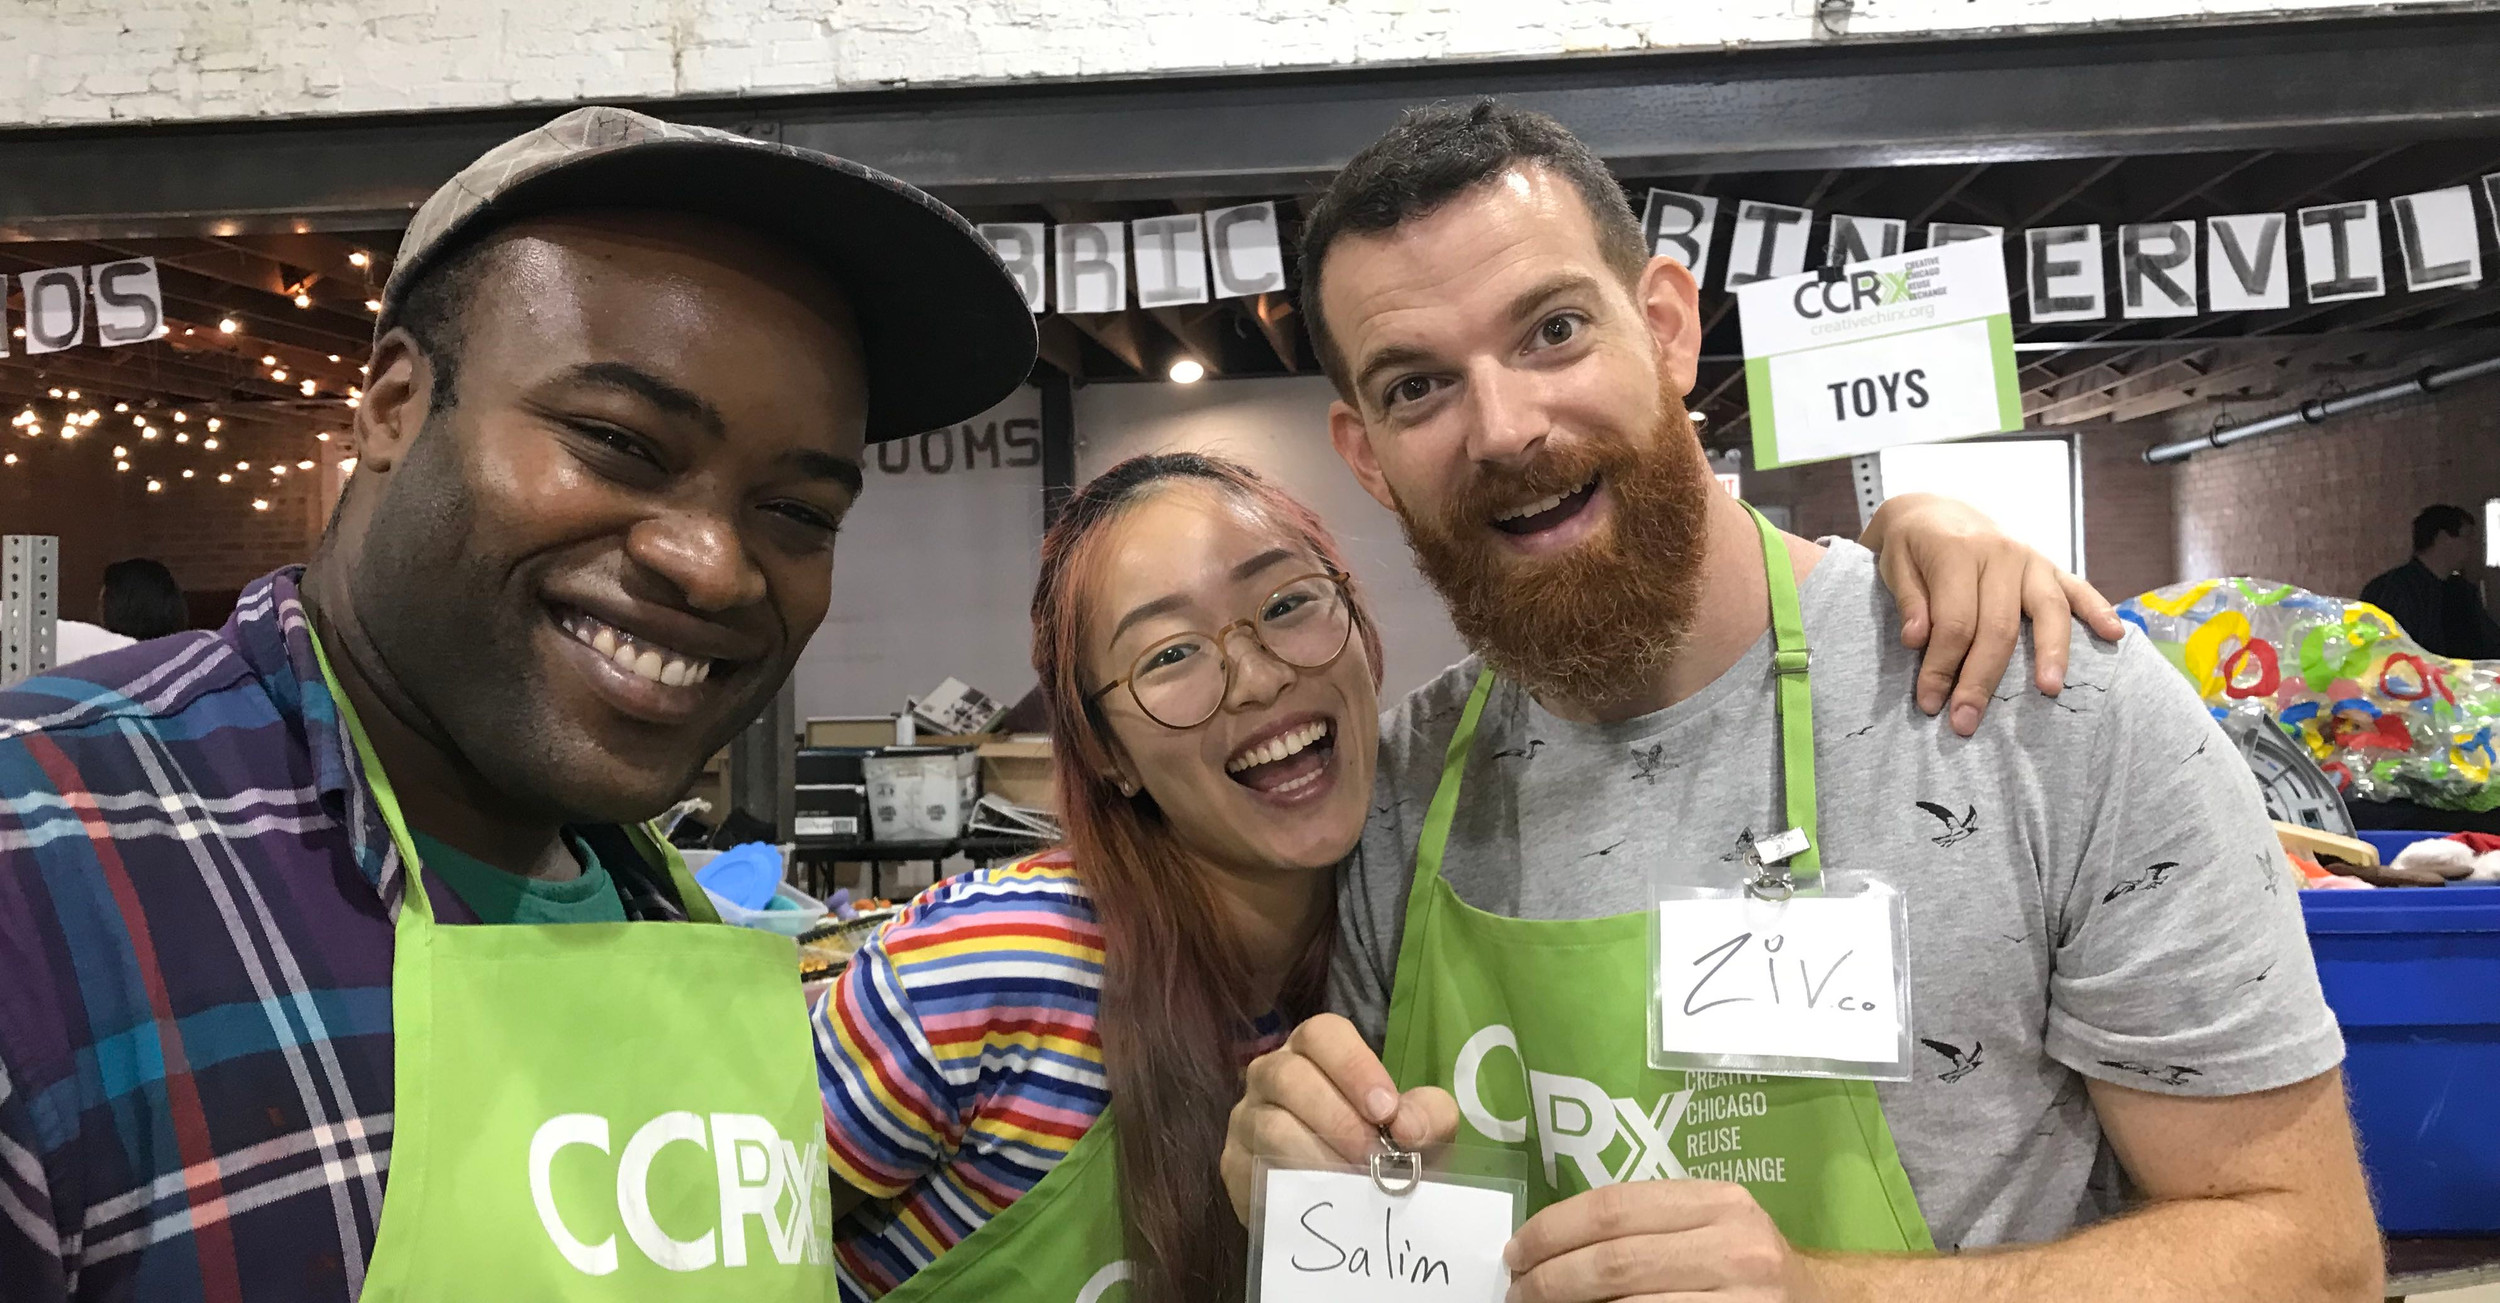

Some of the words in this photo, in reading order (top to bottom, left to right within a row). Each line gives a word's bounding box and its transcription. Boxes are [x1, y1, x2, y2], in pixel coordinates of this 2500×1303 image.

[1647, 177, 2500, 314] BINERVIL
[0, 262, 157, 351] OS
[1827, 368, 1930, 422] TOYS
[1686, 1091, 1768, 1126] CHICAGO
[1686, 1126, 1742, 1159] REUSE
[1291, 1202, 1449, 1286] Salim
